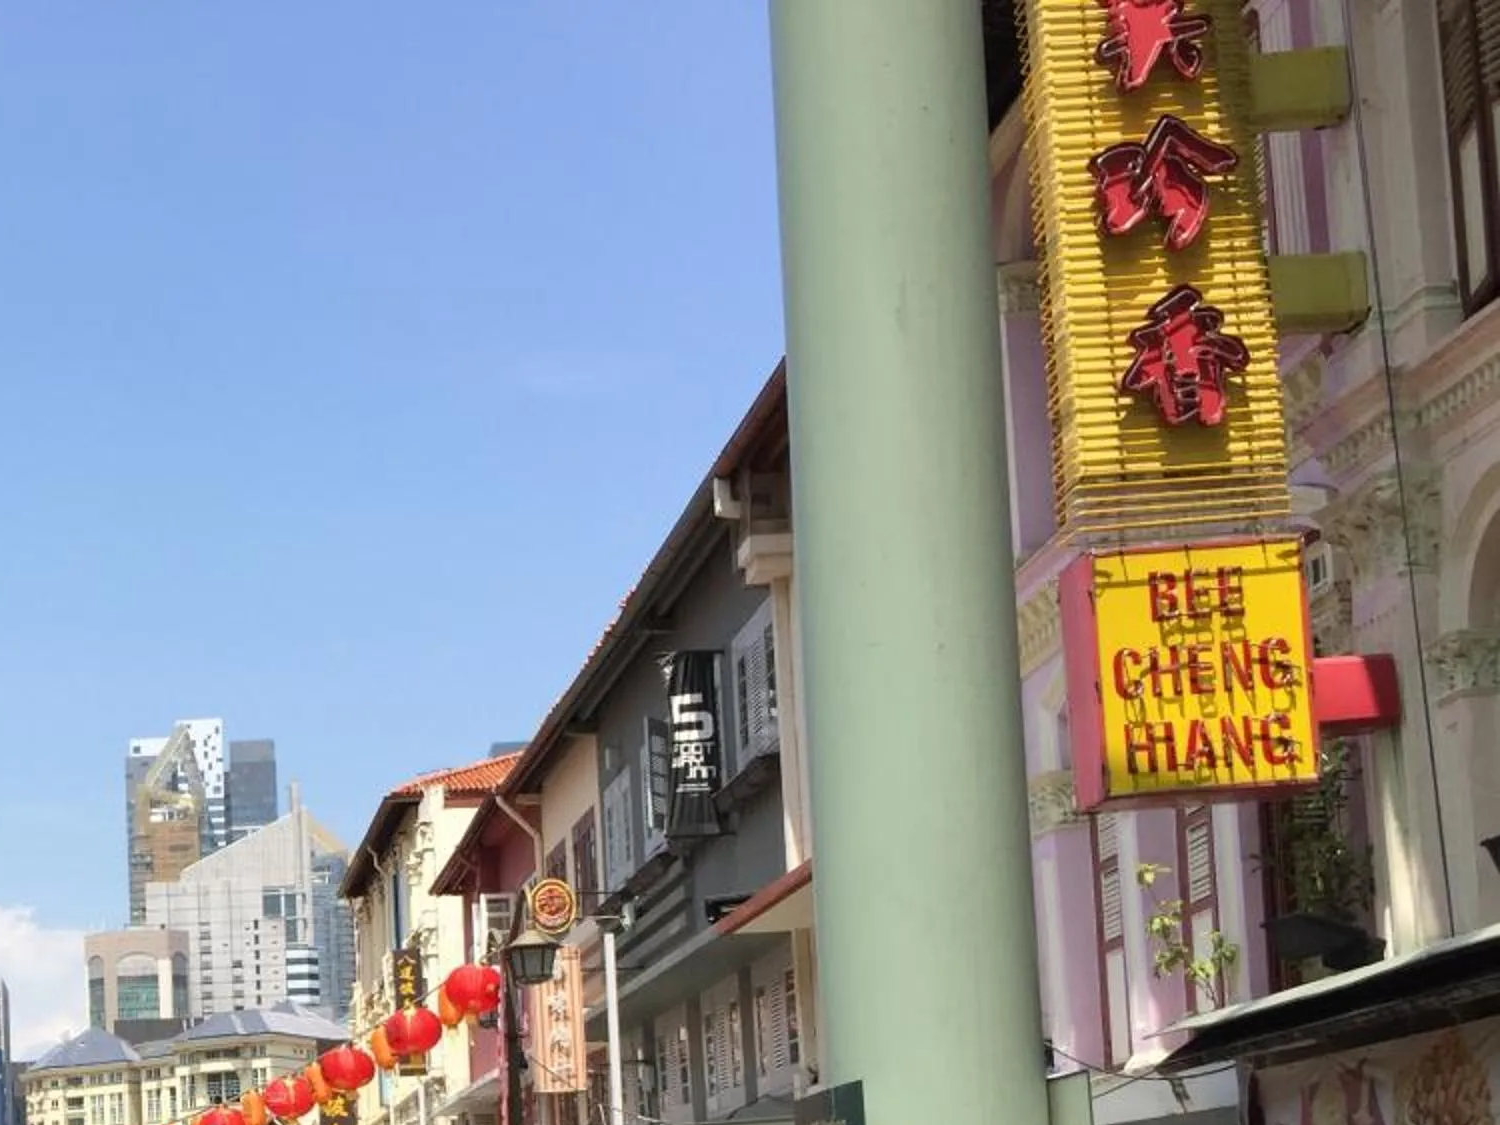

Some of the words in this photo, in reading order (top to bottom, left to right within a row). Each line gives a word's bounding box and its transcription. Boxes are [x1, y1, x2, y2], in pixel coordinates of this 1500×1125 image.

[1147, 565, 1246, 623] BEE
[1113, 637, 1302, 701] CHENG
[670, 693, 715, 741] 5
[1123, 714, 1303, 775] HIANG
